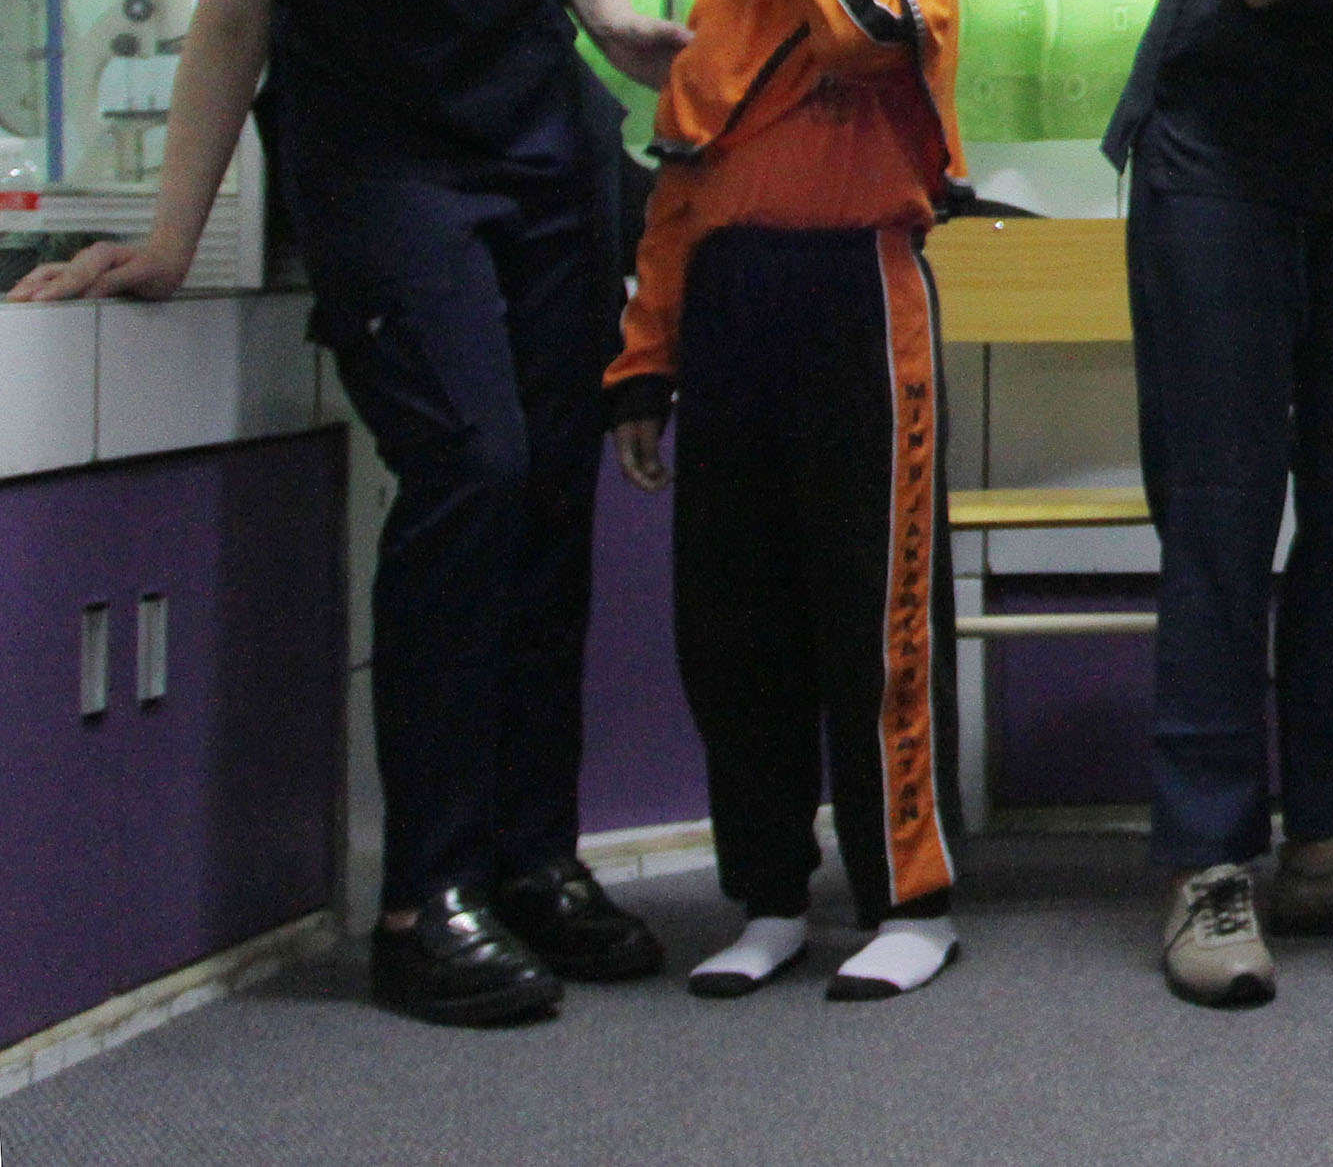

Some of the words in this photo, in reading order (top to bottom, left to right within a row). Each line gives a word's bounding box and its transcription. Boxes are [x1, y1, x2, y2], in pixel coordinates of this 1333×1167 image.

[905, 382, 926, 450] MIN
[899, 491, 924, 656] JAKARTA
[896, 666, 920, 825] SELATAN
